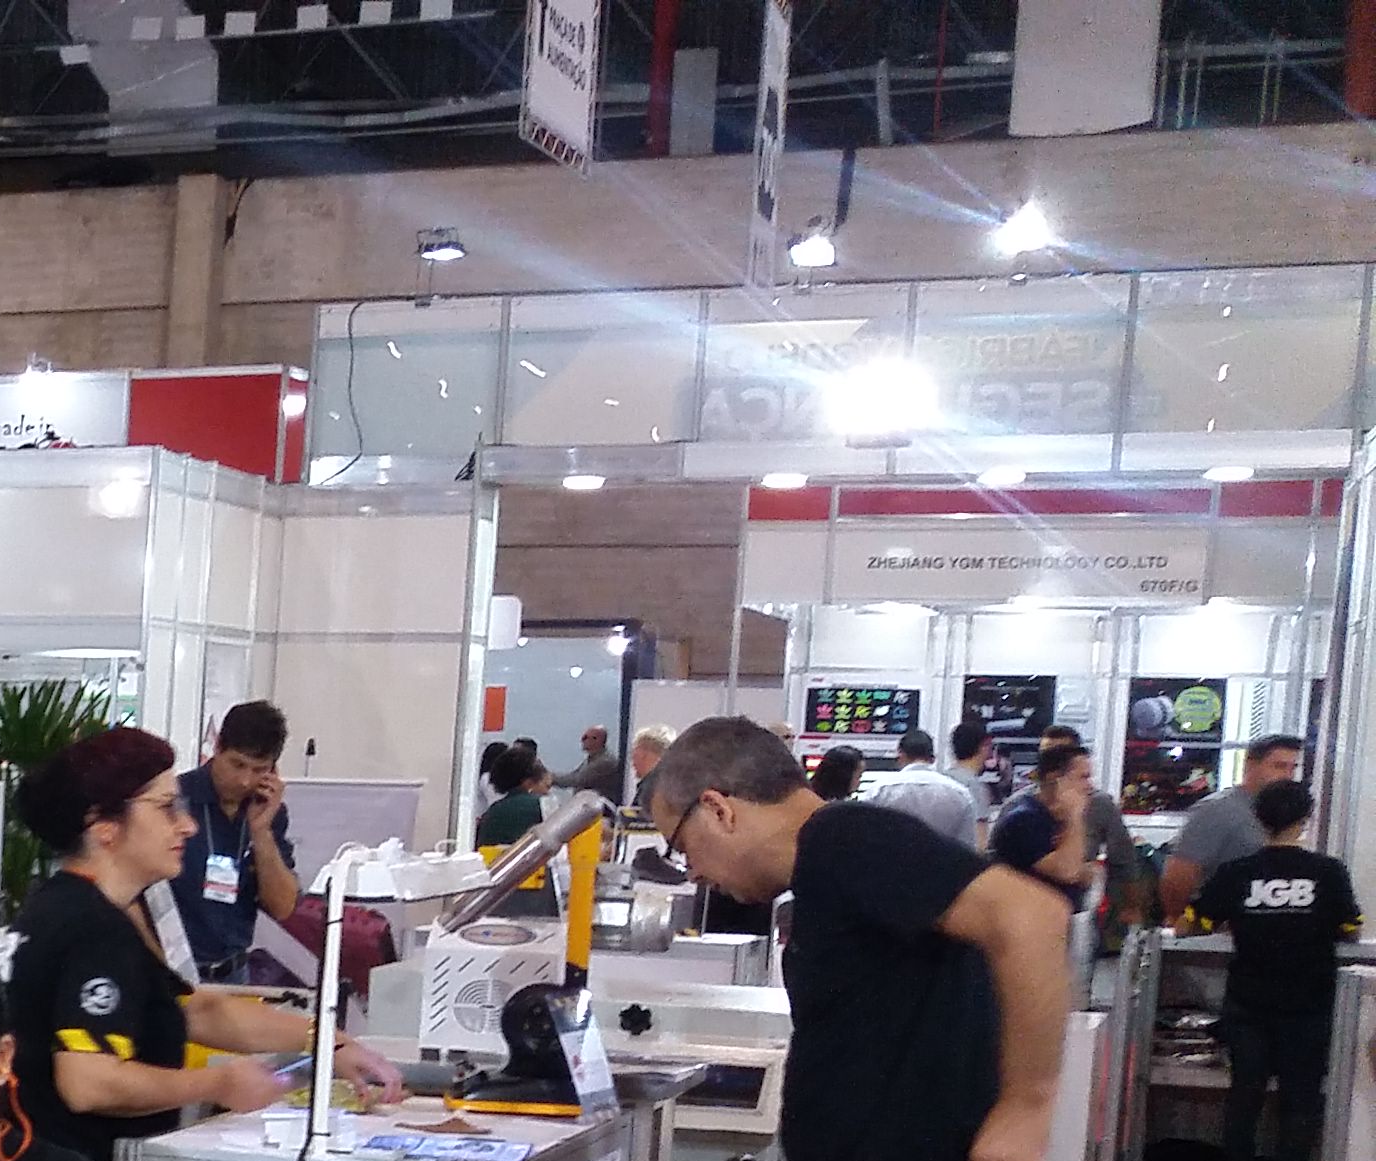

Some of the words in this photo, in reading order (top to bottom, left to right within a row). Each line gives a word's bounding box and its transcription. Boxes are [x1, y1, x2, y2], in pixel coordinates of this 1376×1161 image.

[867, 556, 945, 570] ZHEJIANG
[987, 556, 1099, 570] TECHNOLOGY
[1244, 879, 1315, 908] JGB
